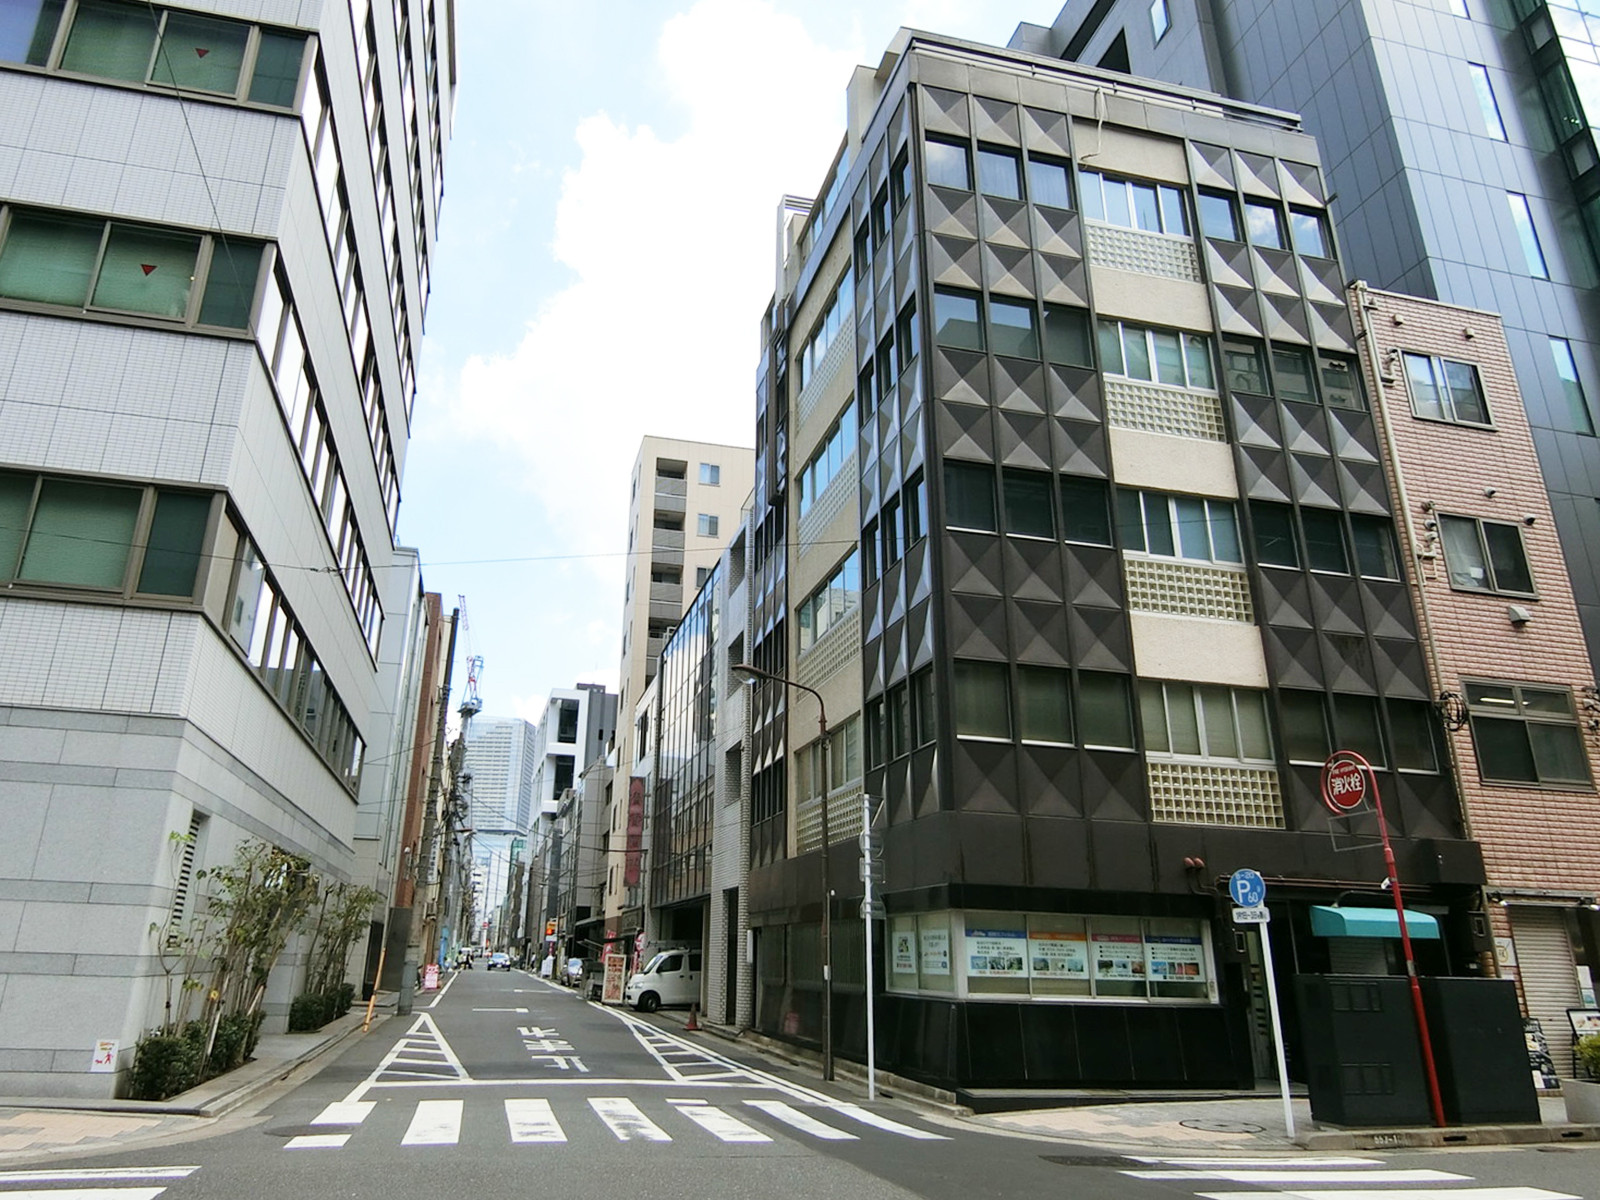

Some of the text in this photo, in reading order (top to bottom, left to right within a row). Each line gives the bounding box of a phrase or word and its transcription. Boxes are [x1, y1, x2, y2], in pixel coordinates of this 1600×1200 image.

[1331, 773, 1362, 795] 消火栓
[1236, 880, 1250, 903] P
